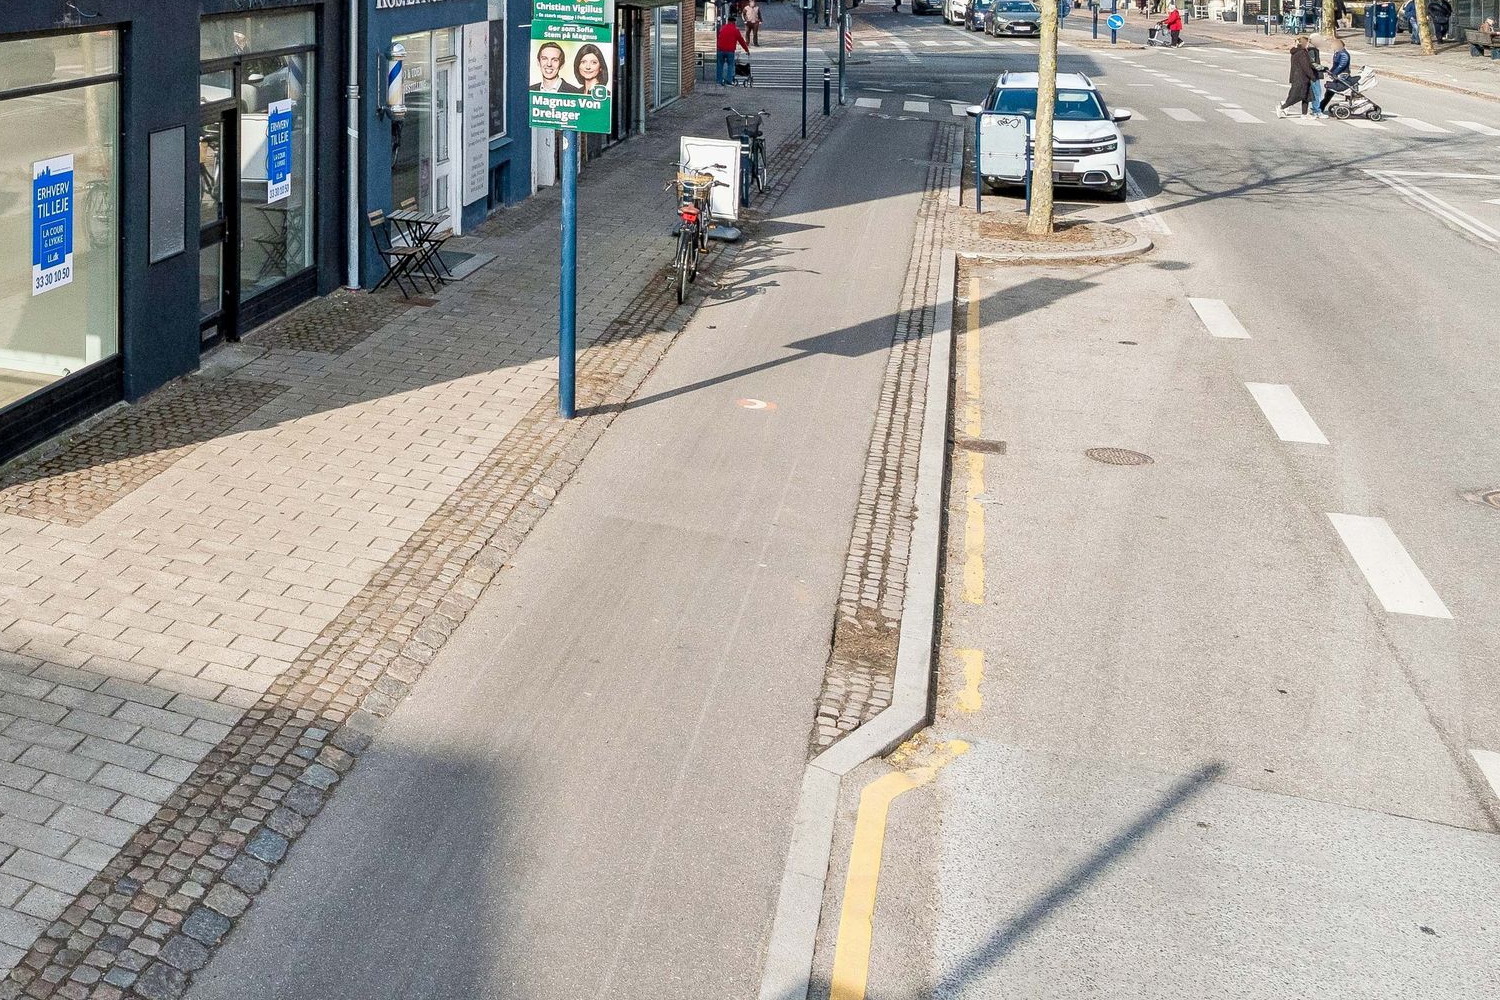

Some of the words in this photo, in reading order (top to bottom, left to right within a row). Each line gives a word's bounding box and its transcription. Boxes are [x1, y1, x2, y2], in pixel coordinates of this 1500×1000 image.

[536, 2, 570, 11] Christian
[572, 4, 602, 14] Vigilius
[532, 96, 576, 108] Magnus
[579, 99, 600, 109] Von
[38, 181, 69, 200] ERHVERV
[38, 203, 50, 219] TIL
[51, 197, 68, 216] LEJE
[50, 225, 63, 236] COUR
[49, 235, 63, 246] LYKKE
[36, 277, 44, 289] 33
[45, 274, 53, 286] 30
[54, 270, 61, 282] 10
[62, 267, 70, 279] 50
